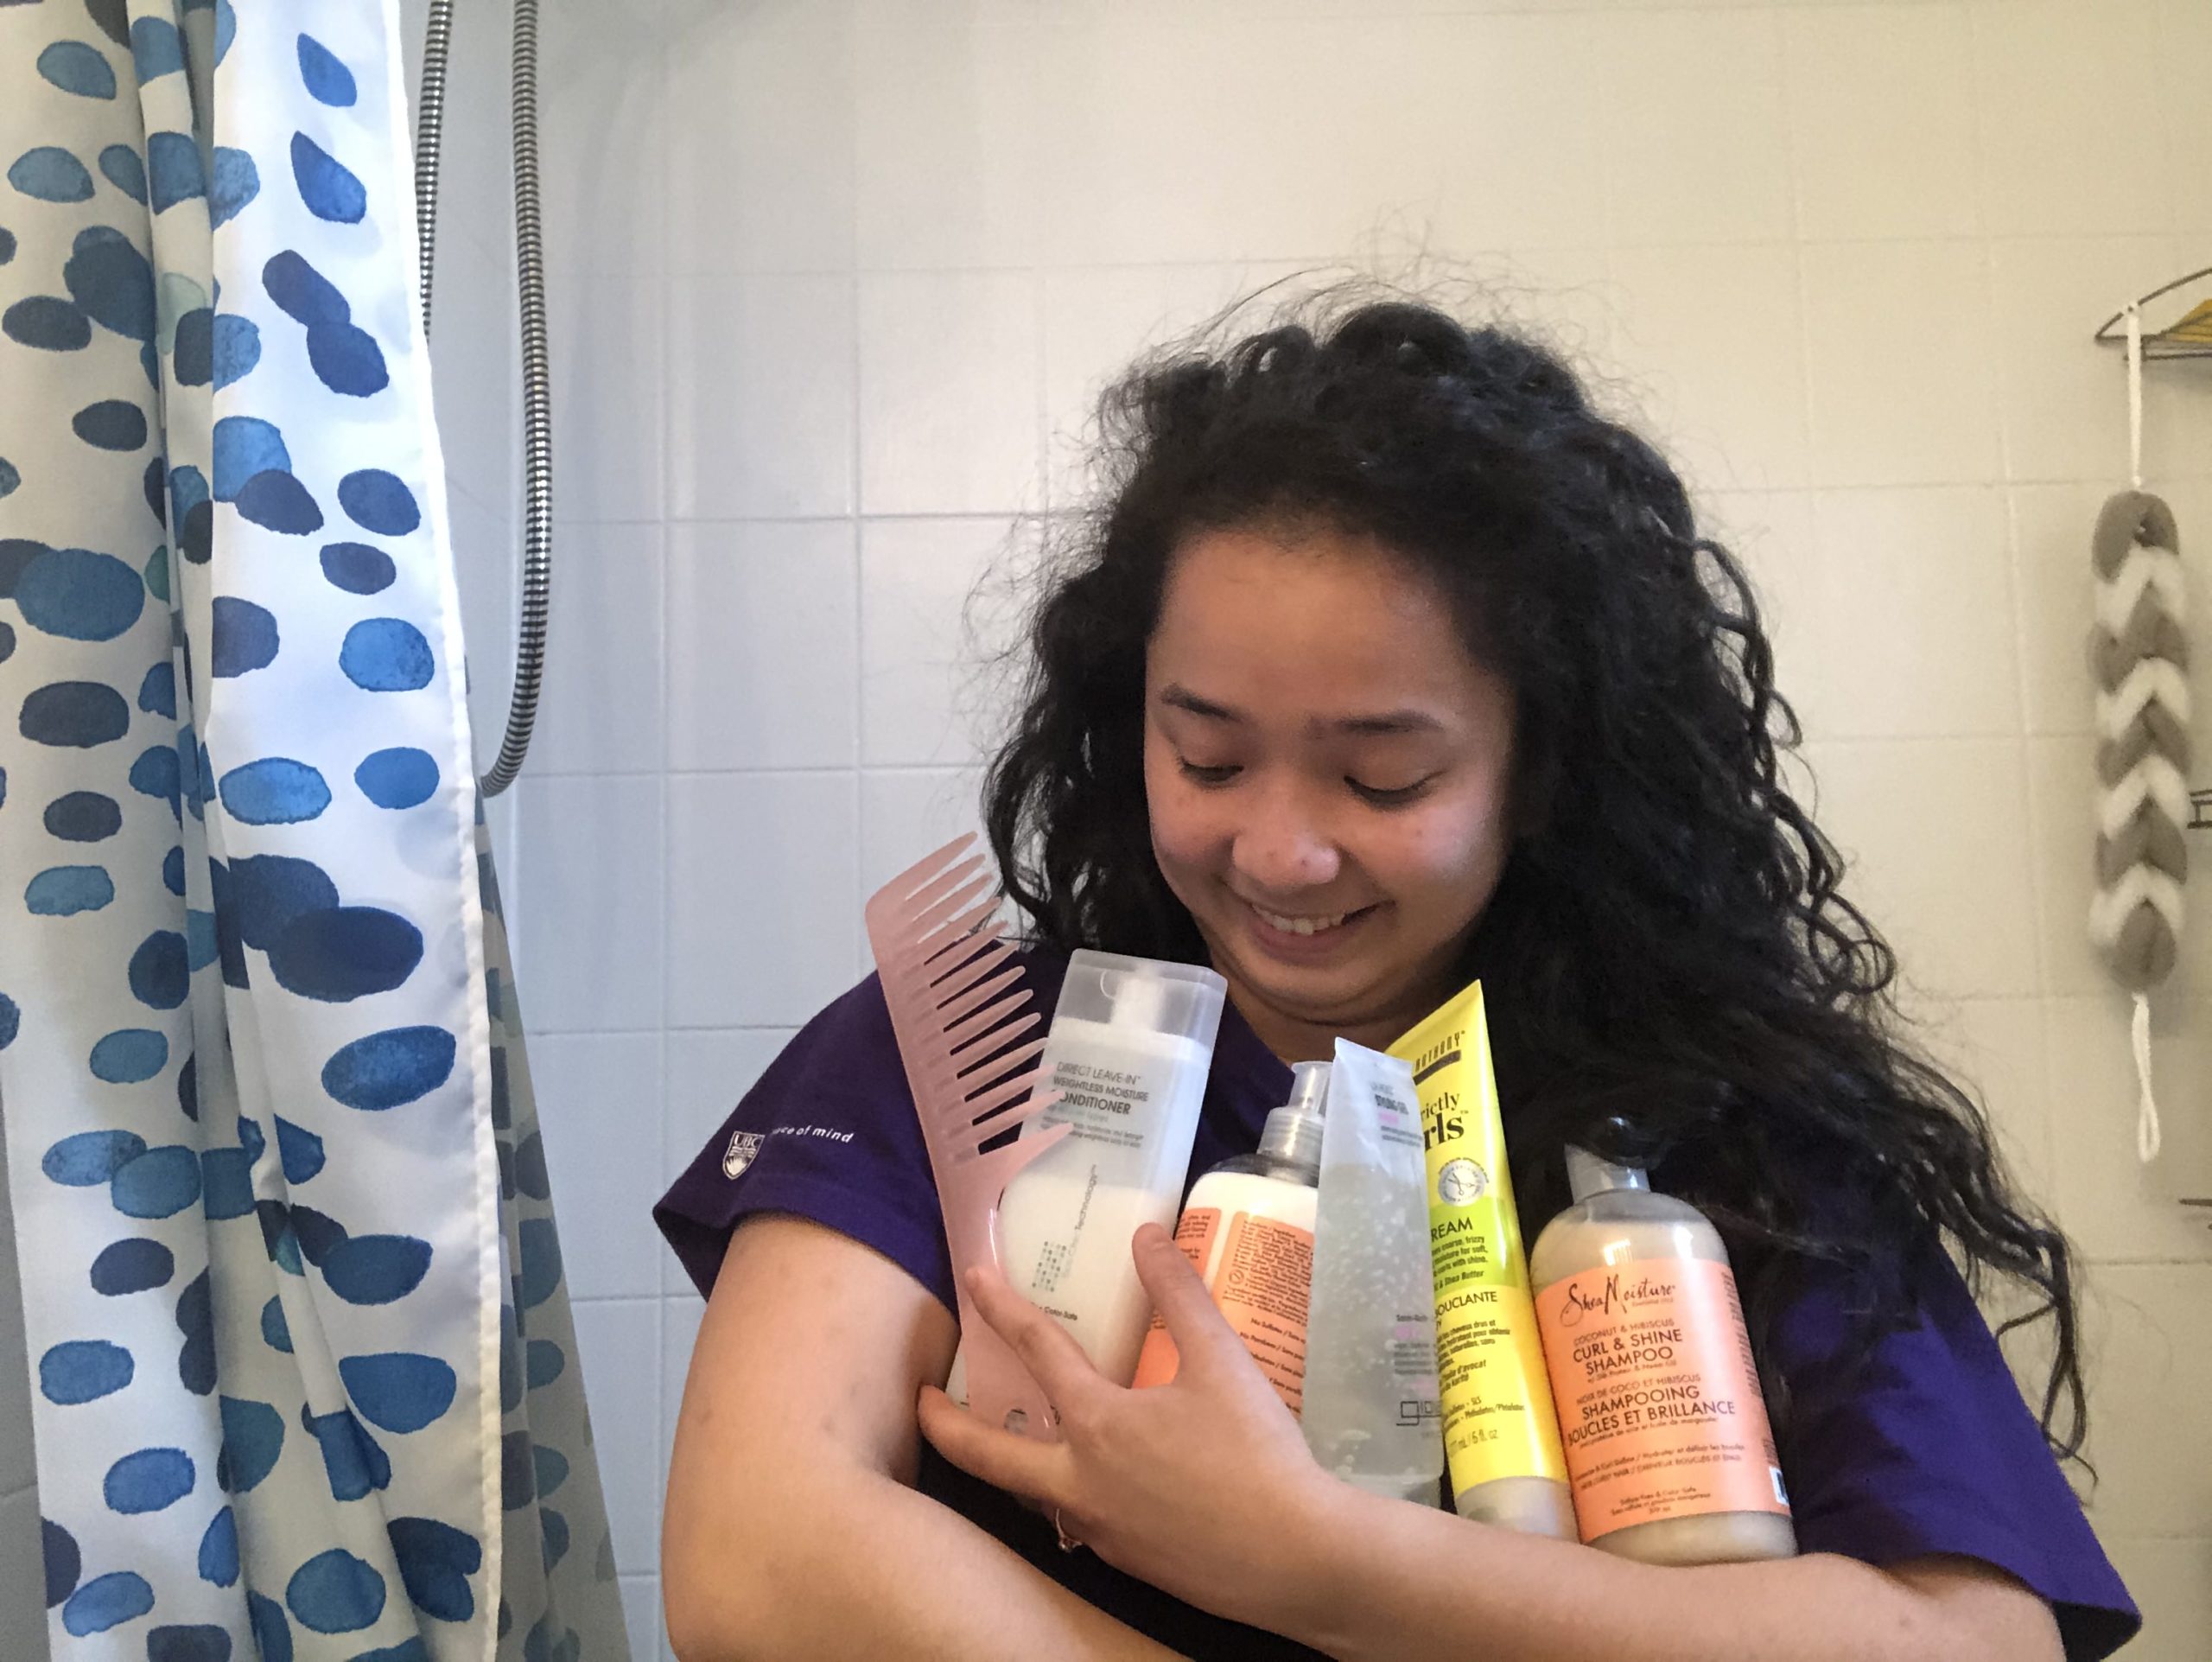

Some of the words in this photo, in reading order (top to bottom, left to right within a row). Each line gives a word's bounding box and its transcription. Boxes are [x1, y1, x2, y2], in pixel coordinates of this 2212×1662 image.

[1057, 1061, 1091, 1077] DIRECT
[1052, 1075, 1104, 1093] WEIGHTLESS
[1105, 1086, 1149, 1102] MOISTURE
[1052, 1088, 1131, 1115] ONDITIONER
[1421, 1092, 1461, 1122] rictly
[734, 1133, 761, 1149] UBC
[796, 1124, 812, 1136] of
[812, 1127, 854, 1143] mind
[1423, 1111, 1465, 1153] rls
[1431, 1216, 1473, 1243] REAM
[1452, 1258, 1466, 1268] with
[1445, 1274, 1460, 1286] Shea
[1461, 1270, 1484, 1281] Butter
[1573, 1326, 1618, 1347] COCONUT
[1630, 1318, 1675, 1331] HIBISCUS
[1573, 1341, 1609, 1363] CURL
[1613, 1337, 1625, 1351] &
[1630, 1328, 1682, 1347] SHINE
[1586, 1346, 1674, 1375] SHAMPOO
[1598, 1388, 1608, 1398] DE
[1611, 1380, 1641, 1395] COCO
[1643, 1378, 1654, 1387] ET
[1656, 1373, 1701, 1385] HIBISCUS
[1582, 1385, 1700, 1420] SHAMPOOING
[1624, 1410, 1641, 1425] ET
[1647, 1400, 1736, 1421] BRILLANCE
